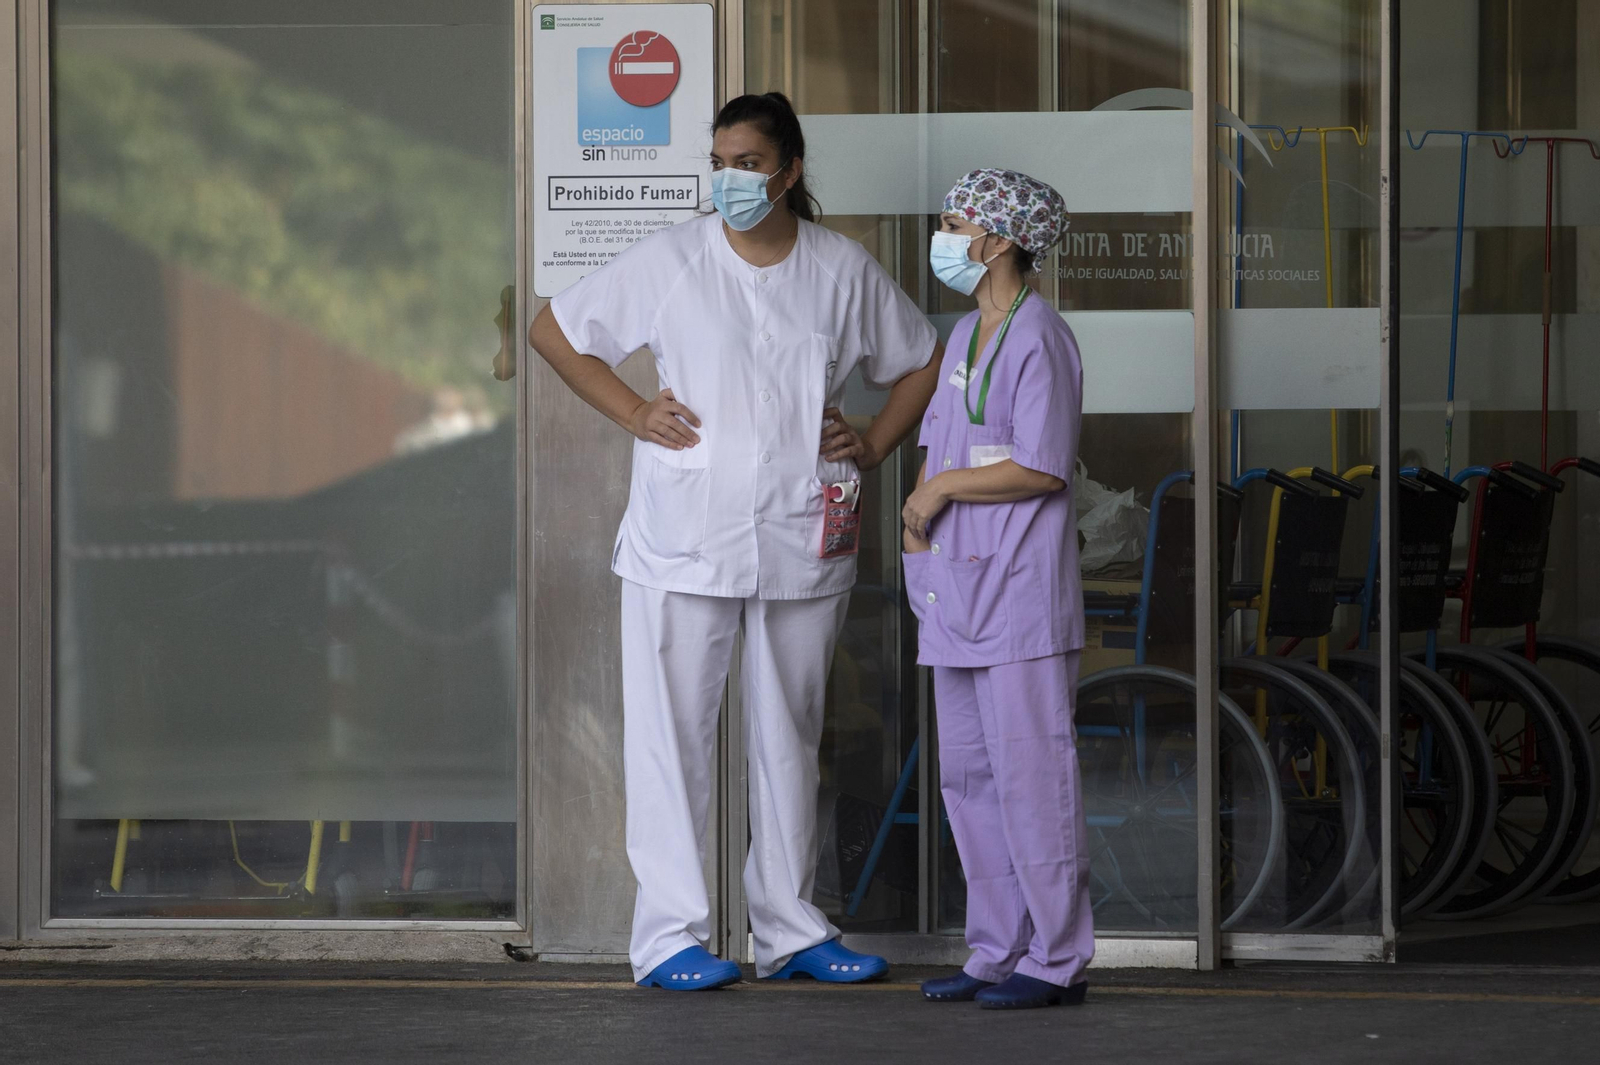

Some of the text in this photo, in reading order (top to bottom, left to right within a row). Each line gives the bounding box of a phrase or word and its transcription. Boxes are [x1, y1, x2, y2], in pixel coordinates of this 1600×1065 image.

[582, 124, 644, 144] espacio
[582, 145, 657, 161] sin humo
[555, 186, 692, 200] Prohibido Fumar
[1057, 233, 1111, 257] UNTA
[1122, 233, 1147, 257] DE
[1078, 268, 1092, 278] DE
[1096, 268, 1157, 281] IGUALDAD,
[1268, 270, 1320, 280] SOCIALES
